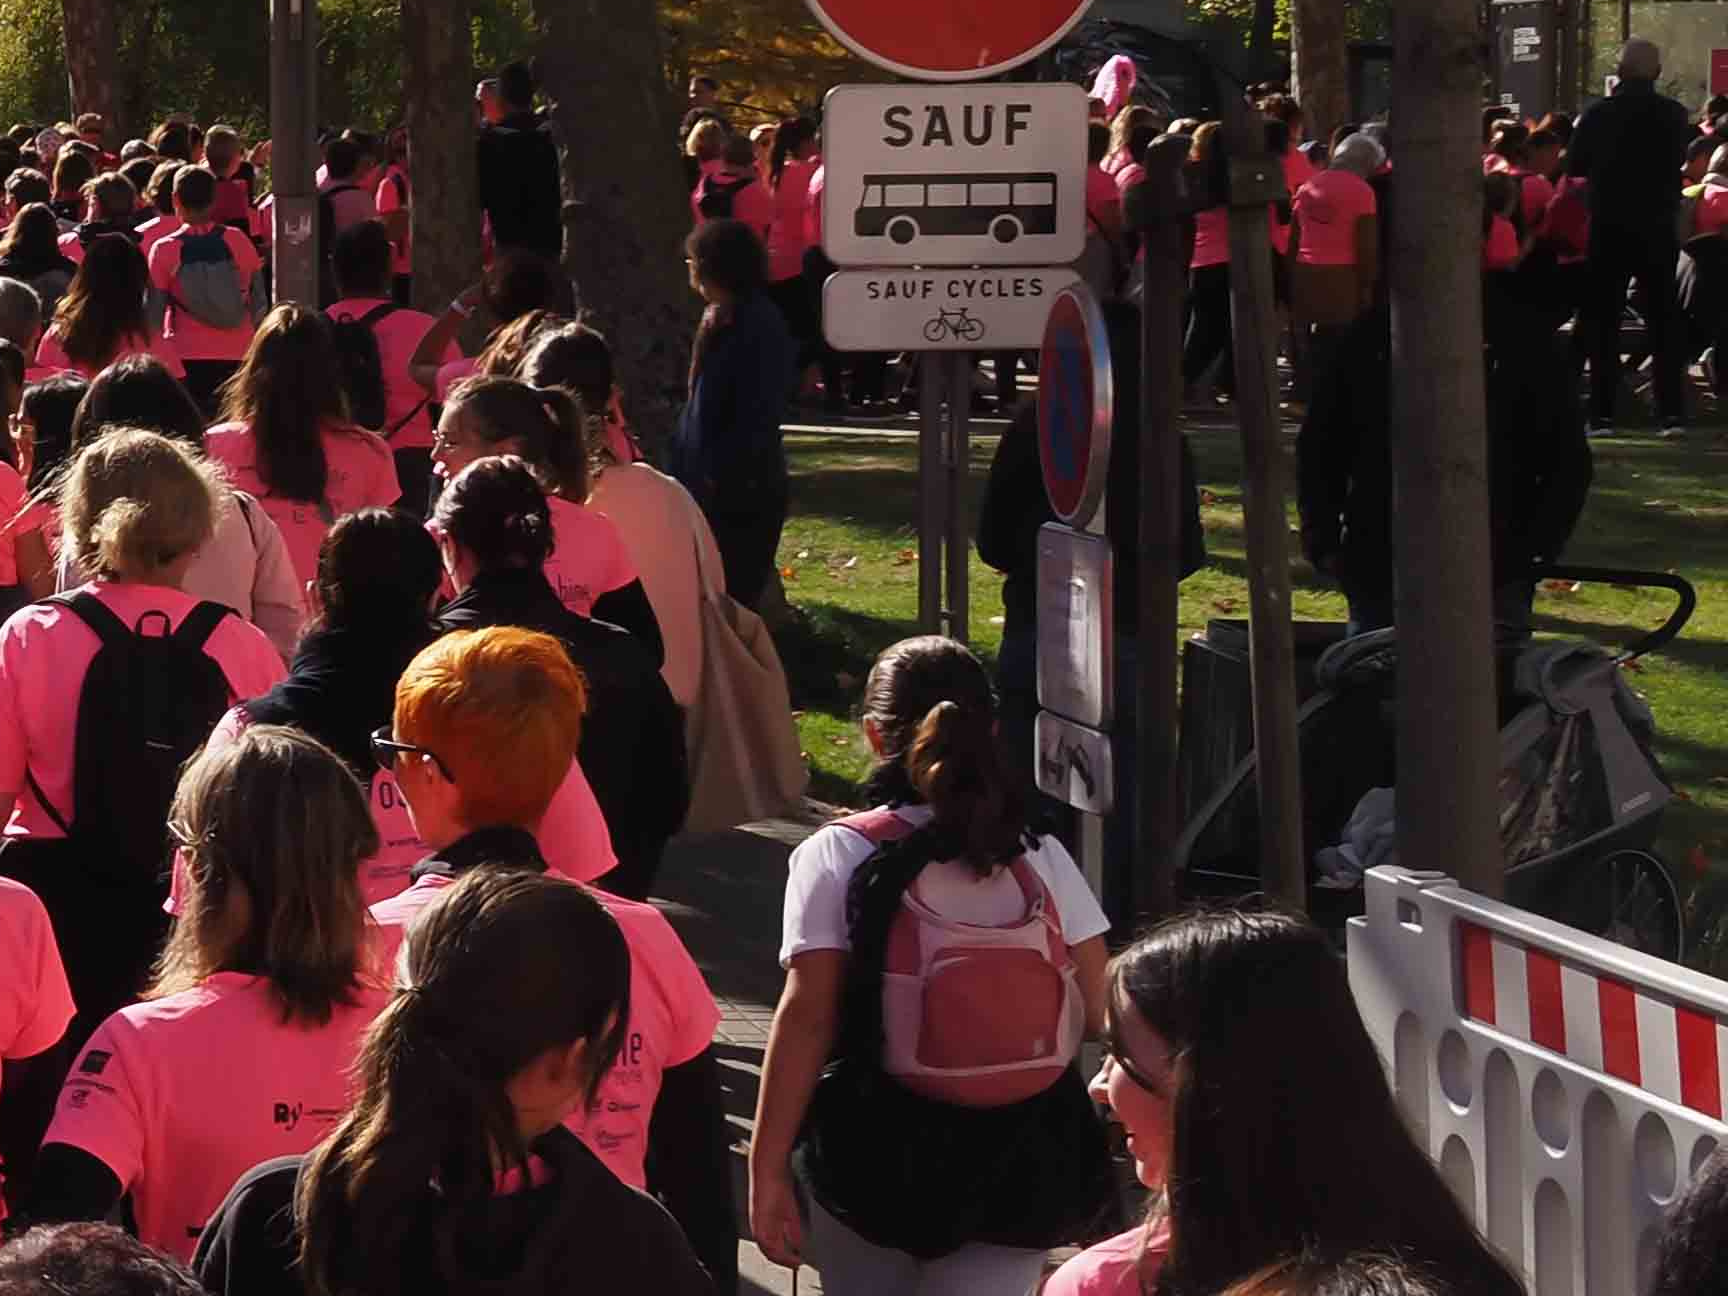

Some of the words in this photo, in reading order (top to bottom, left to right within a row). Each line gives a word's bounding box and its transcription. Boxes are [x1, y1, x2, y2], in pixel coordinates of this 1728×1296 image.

[882, 104, 1033, 147] SAUF
[865, 280, 936, 301] SAUF
[946, 277, 1044, 300] CYCLES
